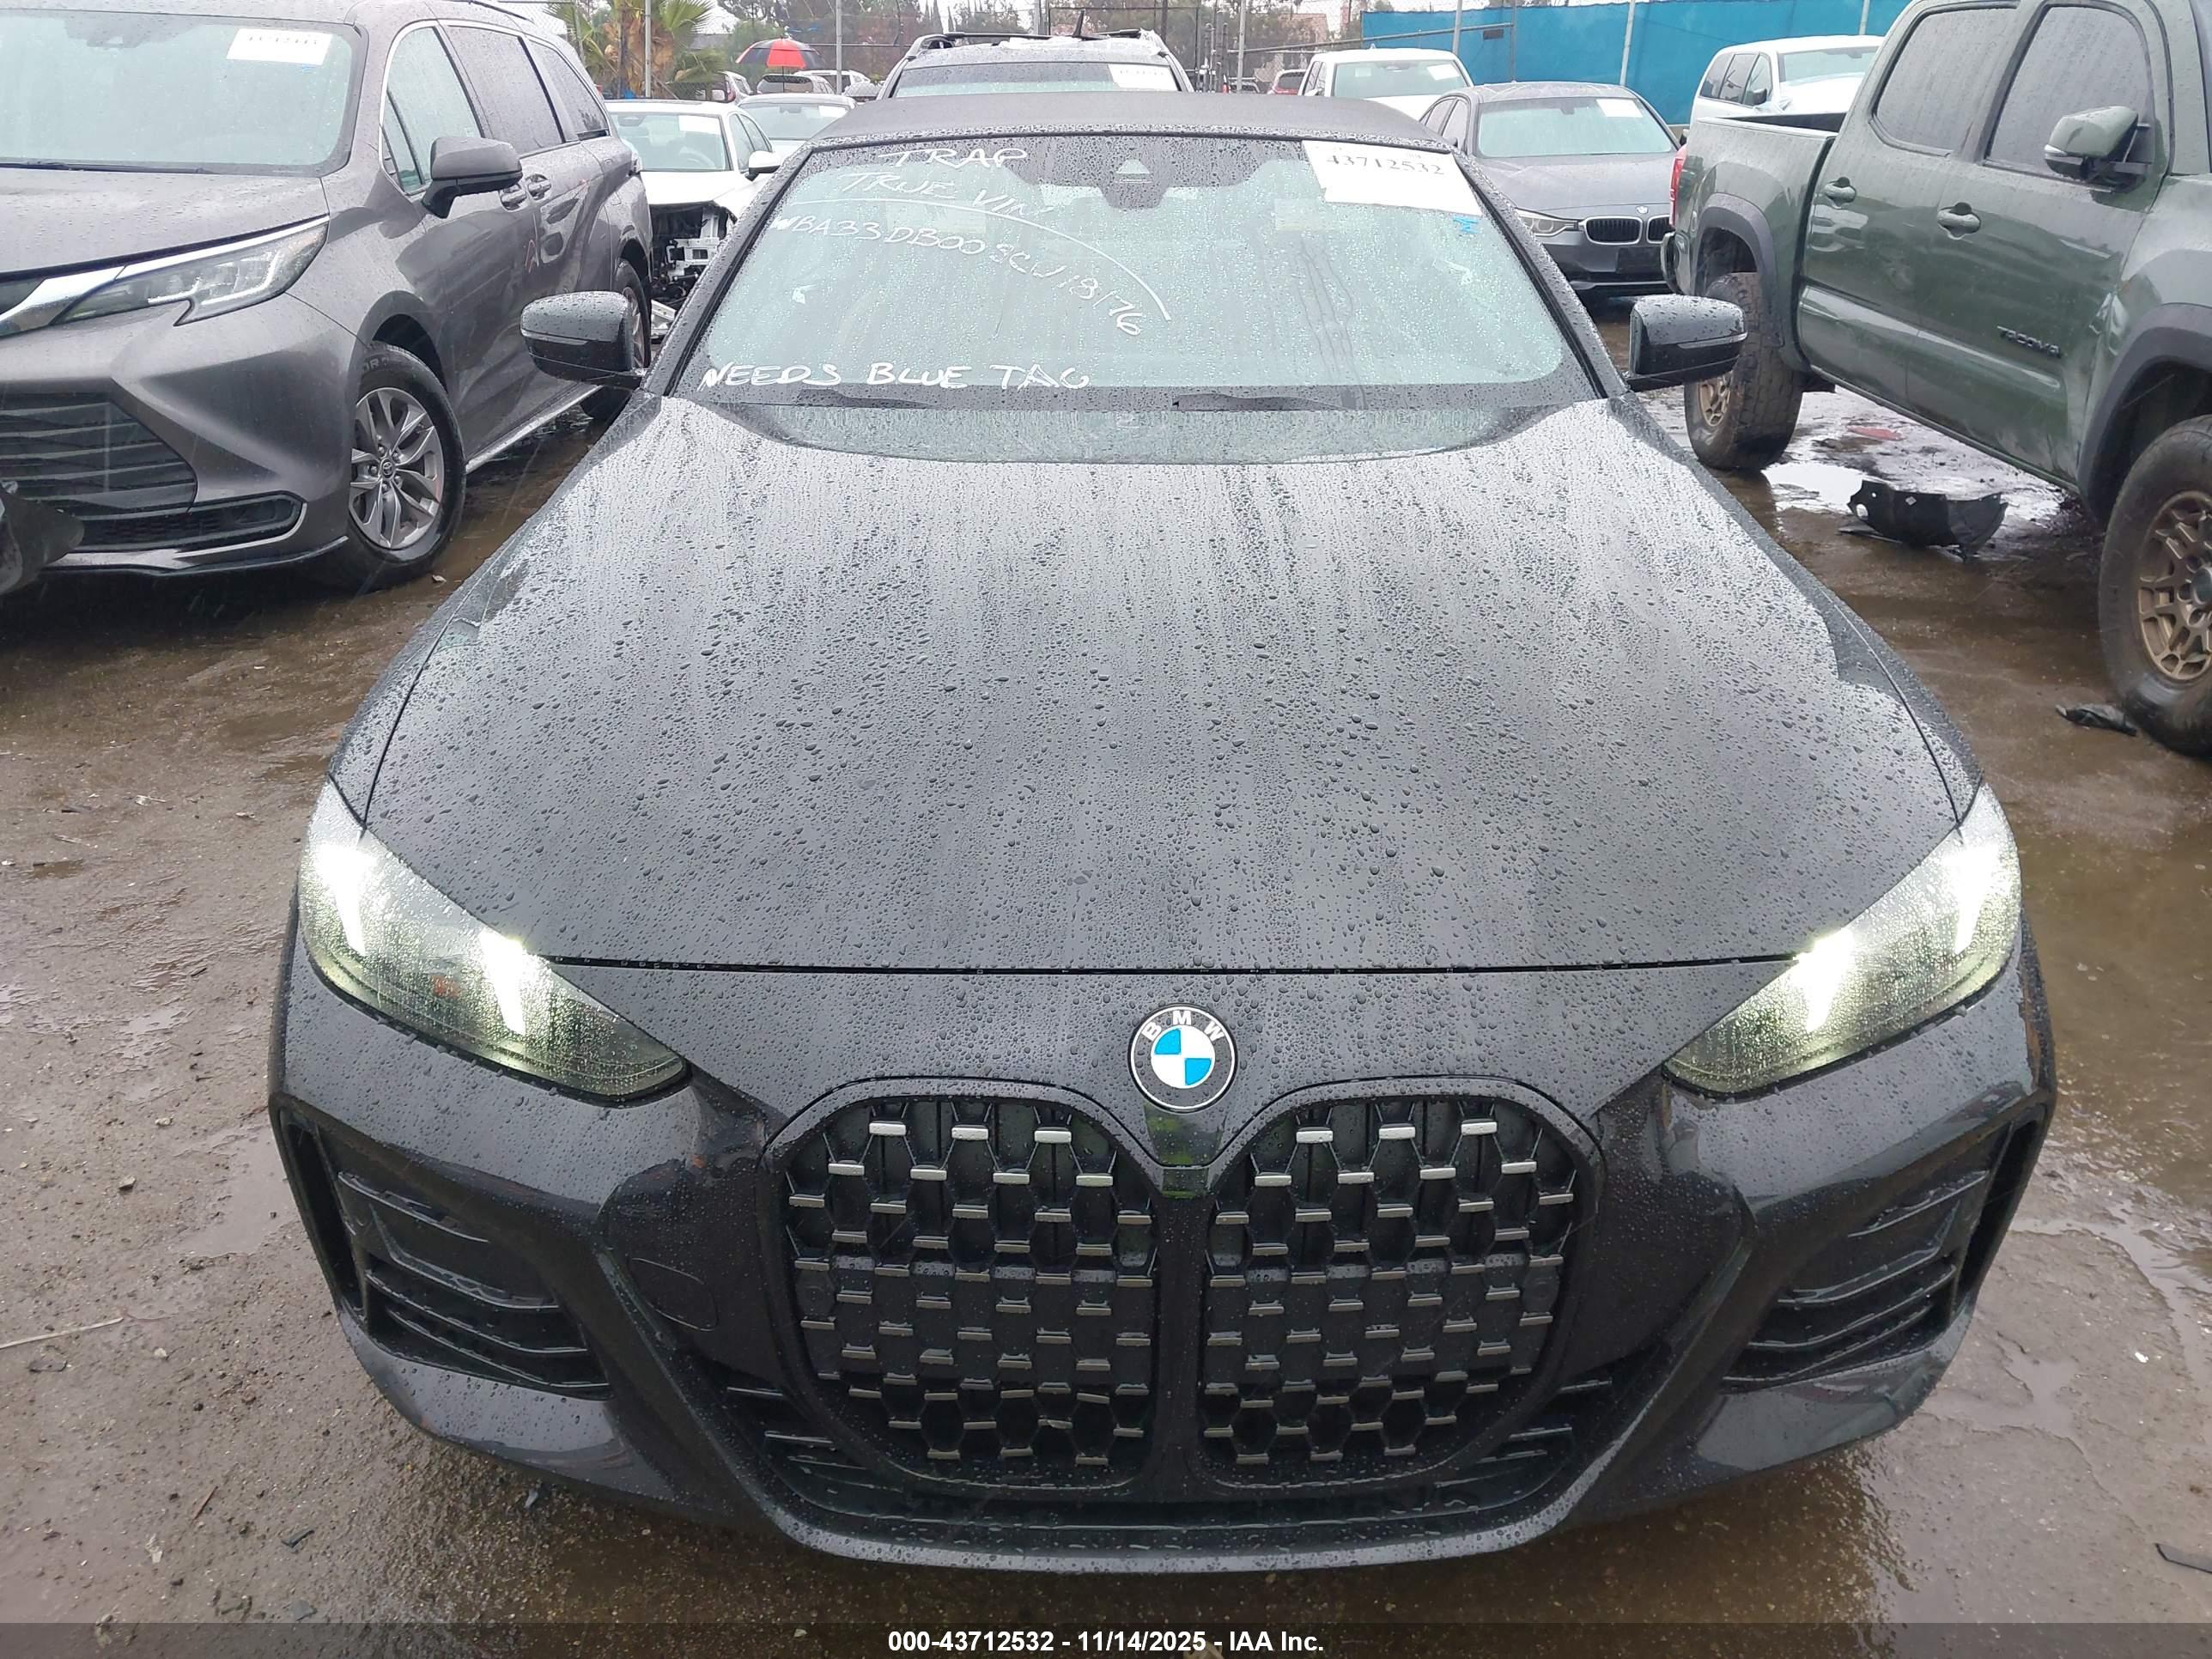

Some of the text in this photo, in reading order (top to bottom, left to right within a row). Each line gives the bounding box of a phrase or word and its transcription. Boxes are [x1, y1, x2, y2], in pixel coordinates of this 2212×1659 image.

[1326, 154, 1444, 174] 43712532
[838, 172, 956, 198] TRUE
[1996, 325, 2061, 358] TACOMA
[697, 362, 842, 392] NEEDS
[866, 362, 972, 389] BLUE
[1141, 1010, 1224, 1042] BMW
